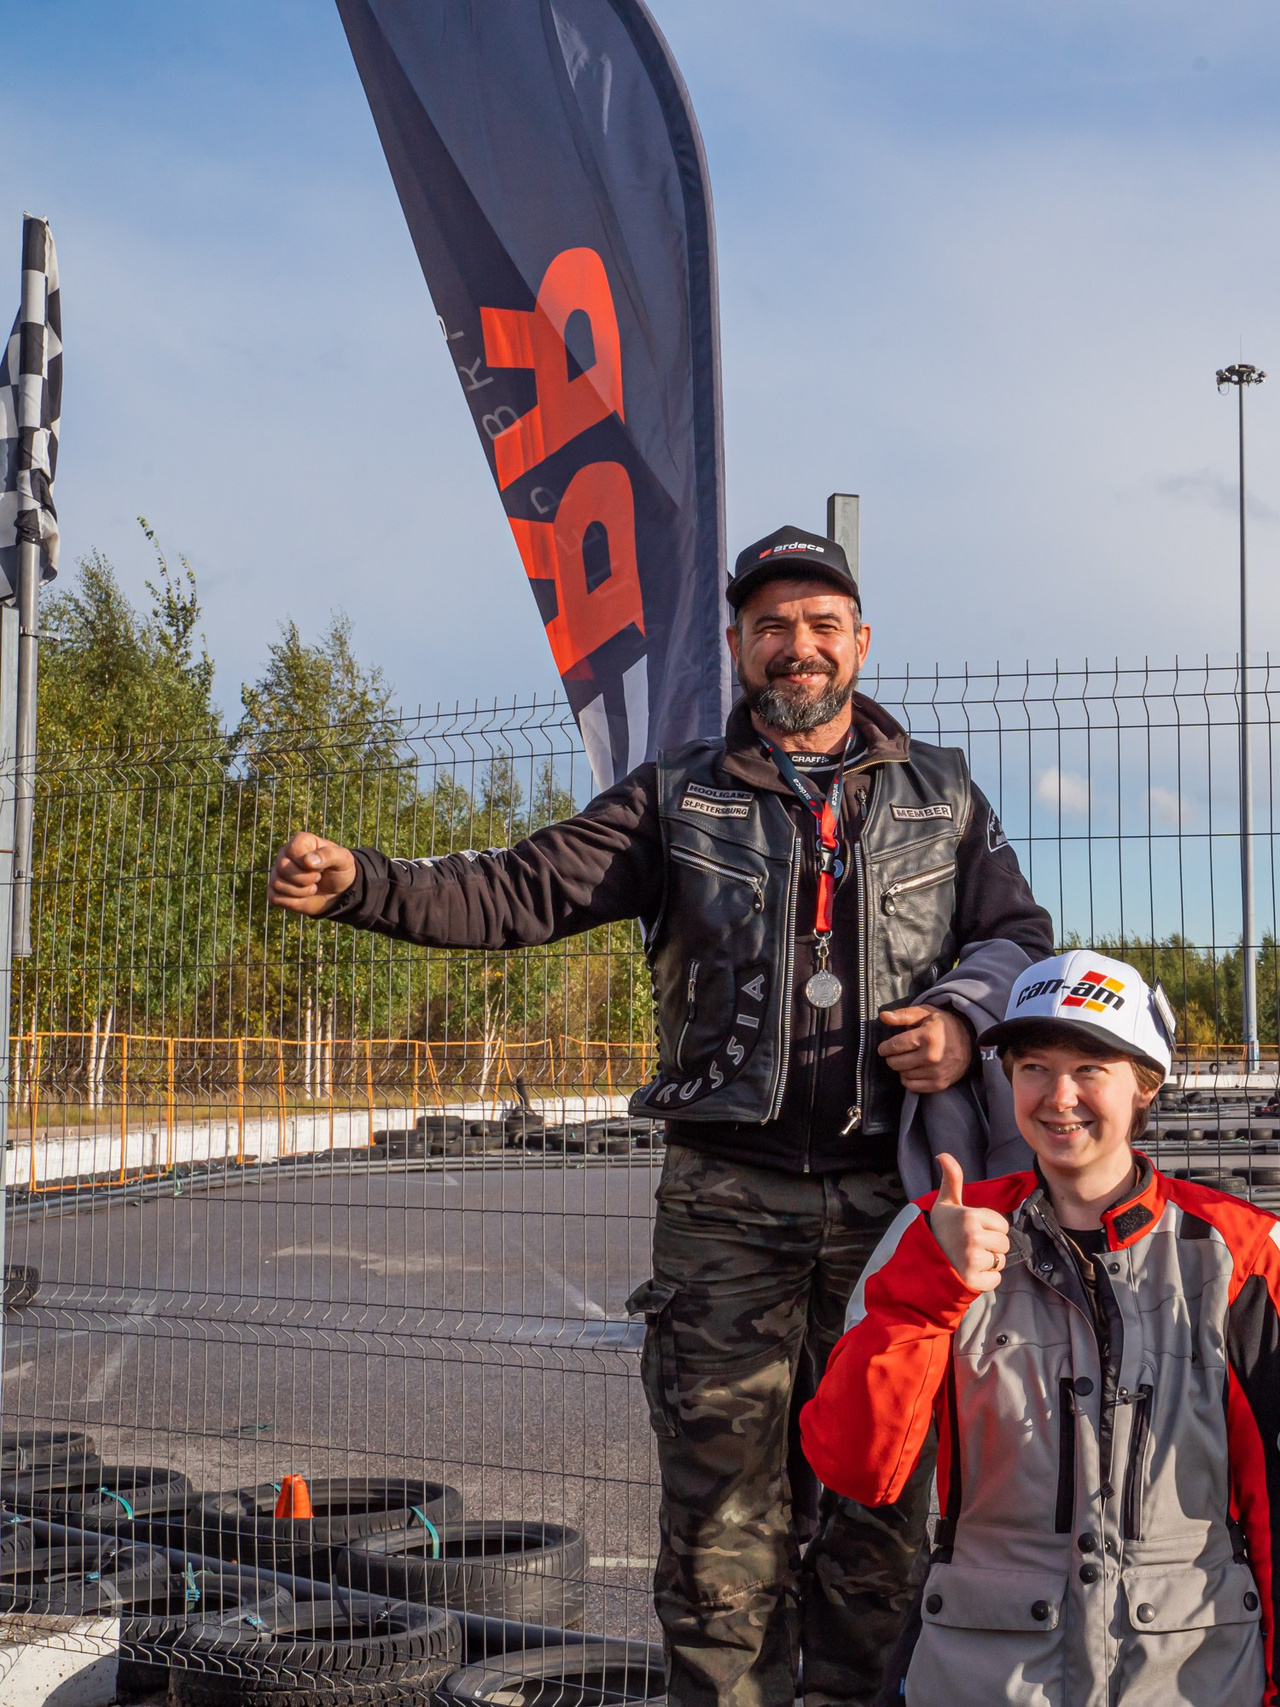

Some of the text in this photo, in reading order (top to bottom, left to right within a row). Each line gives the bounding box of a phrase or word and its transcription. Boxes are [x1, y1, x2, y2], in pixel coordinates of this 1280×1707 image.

[773, 541, 825, 553] ardeca
[791, 755, 821, 763] CRAFT
[689, 785, 753, 800] HOOLIGANS
[793, 778, 811, 800] ardeca
[831, 783, 840, 806] ardeca
[896, 806, 950, 818] MEMBER
[1016, 978, 1126, 1011] can-am
[655, 973, 766, 1104] RUSSIA
